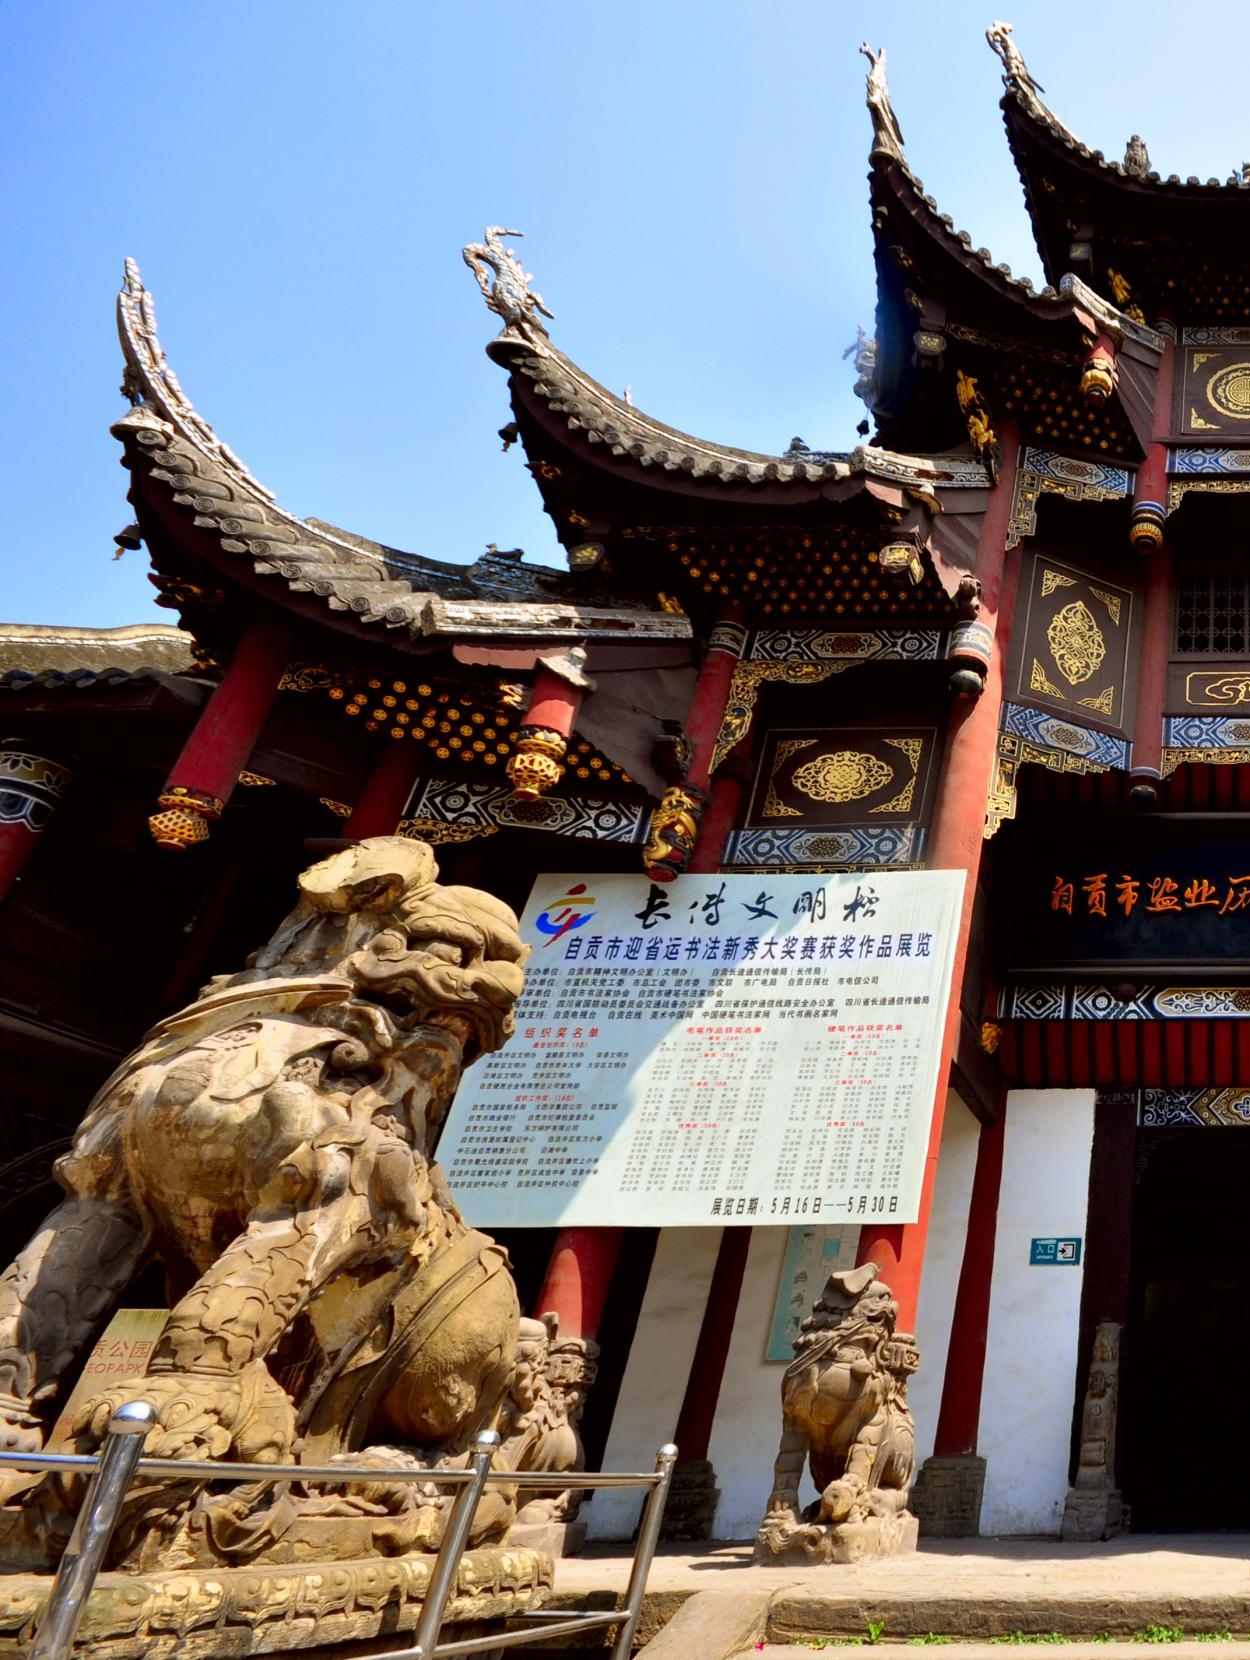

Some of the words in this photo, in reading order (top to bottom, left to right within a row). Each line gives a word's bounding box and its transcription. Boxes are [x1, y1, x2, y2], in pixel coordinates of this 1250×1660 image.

[564, 931, 933, 961] 自贡市迎省运书法新秀大奖赛获奖作品展览
[632, 978, 667, 987] 市总工会
[787, 977, 829, 986] 自贡日报社
[837, 976, 879, 986] 市电信公司
[845, 996, 930, 1007] 四川省长途通信传输局
[523, 1027, 600, 1039] 组织奖名单
[827, 1023, 904, 1033] 硬笔作品获奖名单
[1036, 1244, 1055, 1253] 入口
[84, 1362, 144, 1375] EOPARK
